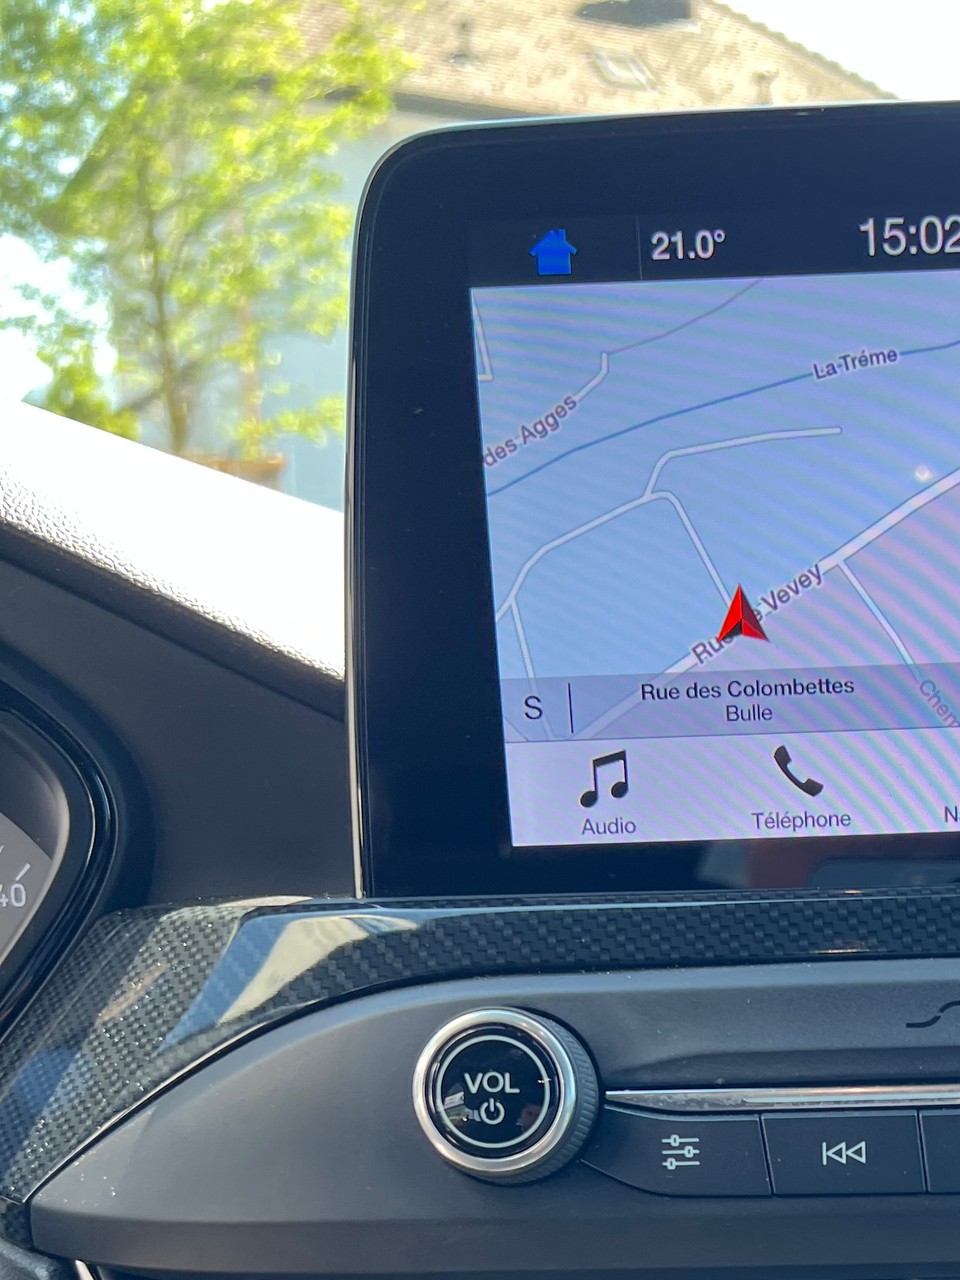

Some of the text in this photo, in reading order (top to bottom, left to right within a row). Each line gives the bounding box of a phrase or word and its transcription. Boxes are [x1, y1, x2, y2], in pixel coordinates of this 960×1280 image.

[651, 229, 726, 261] 21.0°
[521, 396, 577, 438] Agges
[760, 563, 822, 611] Vevey
[640, 677, 855, 701] Rue des Colombettes
[523, 695, 543, 720] S
[725, 703, 774, 723] Bulle
[581, 817, 636, 836] Audio
[751, 809, 851, 832] Téléphone
[464, 1071, 520, 1095] VOL
